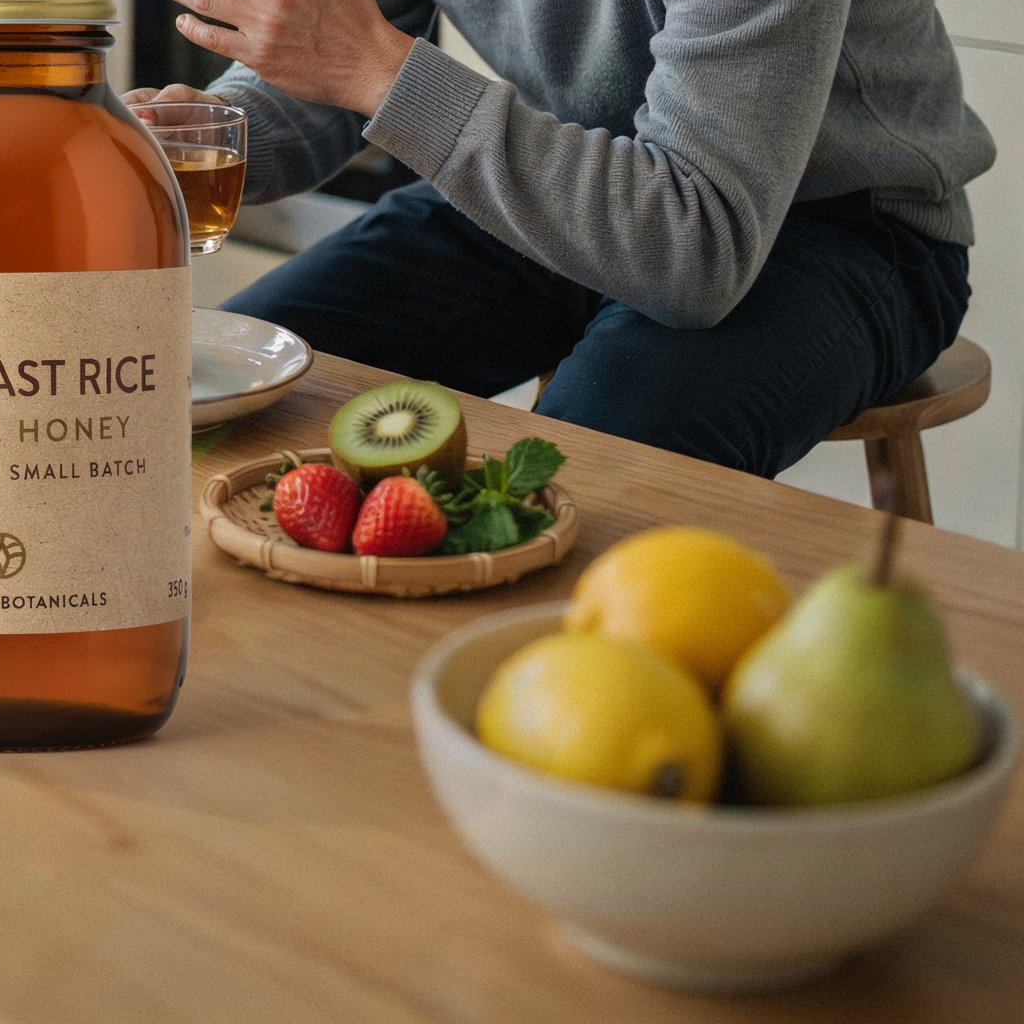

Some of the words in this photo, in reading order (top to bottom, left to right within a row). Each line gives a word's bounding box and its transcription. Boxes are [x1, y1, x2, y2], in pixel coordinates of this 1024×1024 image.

[80, 354, 156, 395] RICE
[19, 415, 131, 442] HONEY
[9, 463, 81, 480] SMALL
[89, 458, 146, 478] BATCH
[167, 579, 183, 598] 350
[1, 592, 108, 610] BOTANICALS
